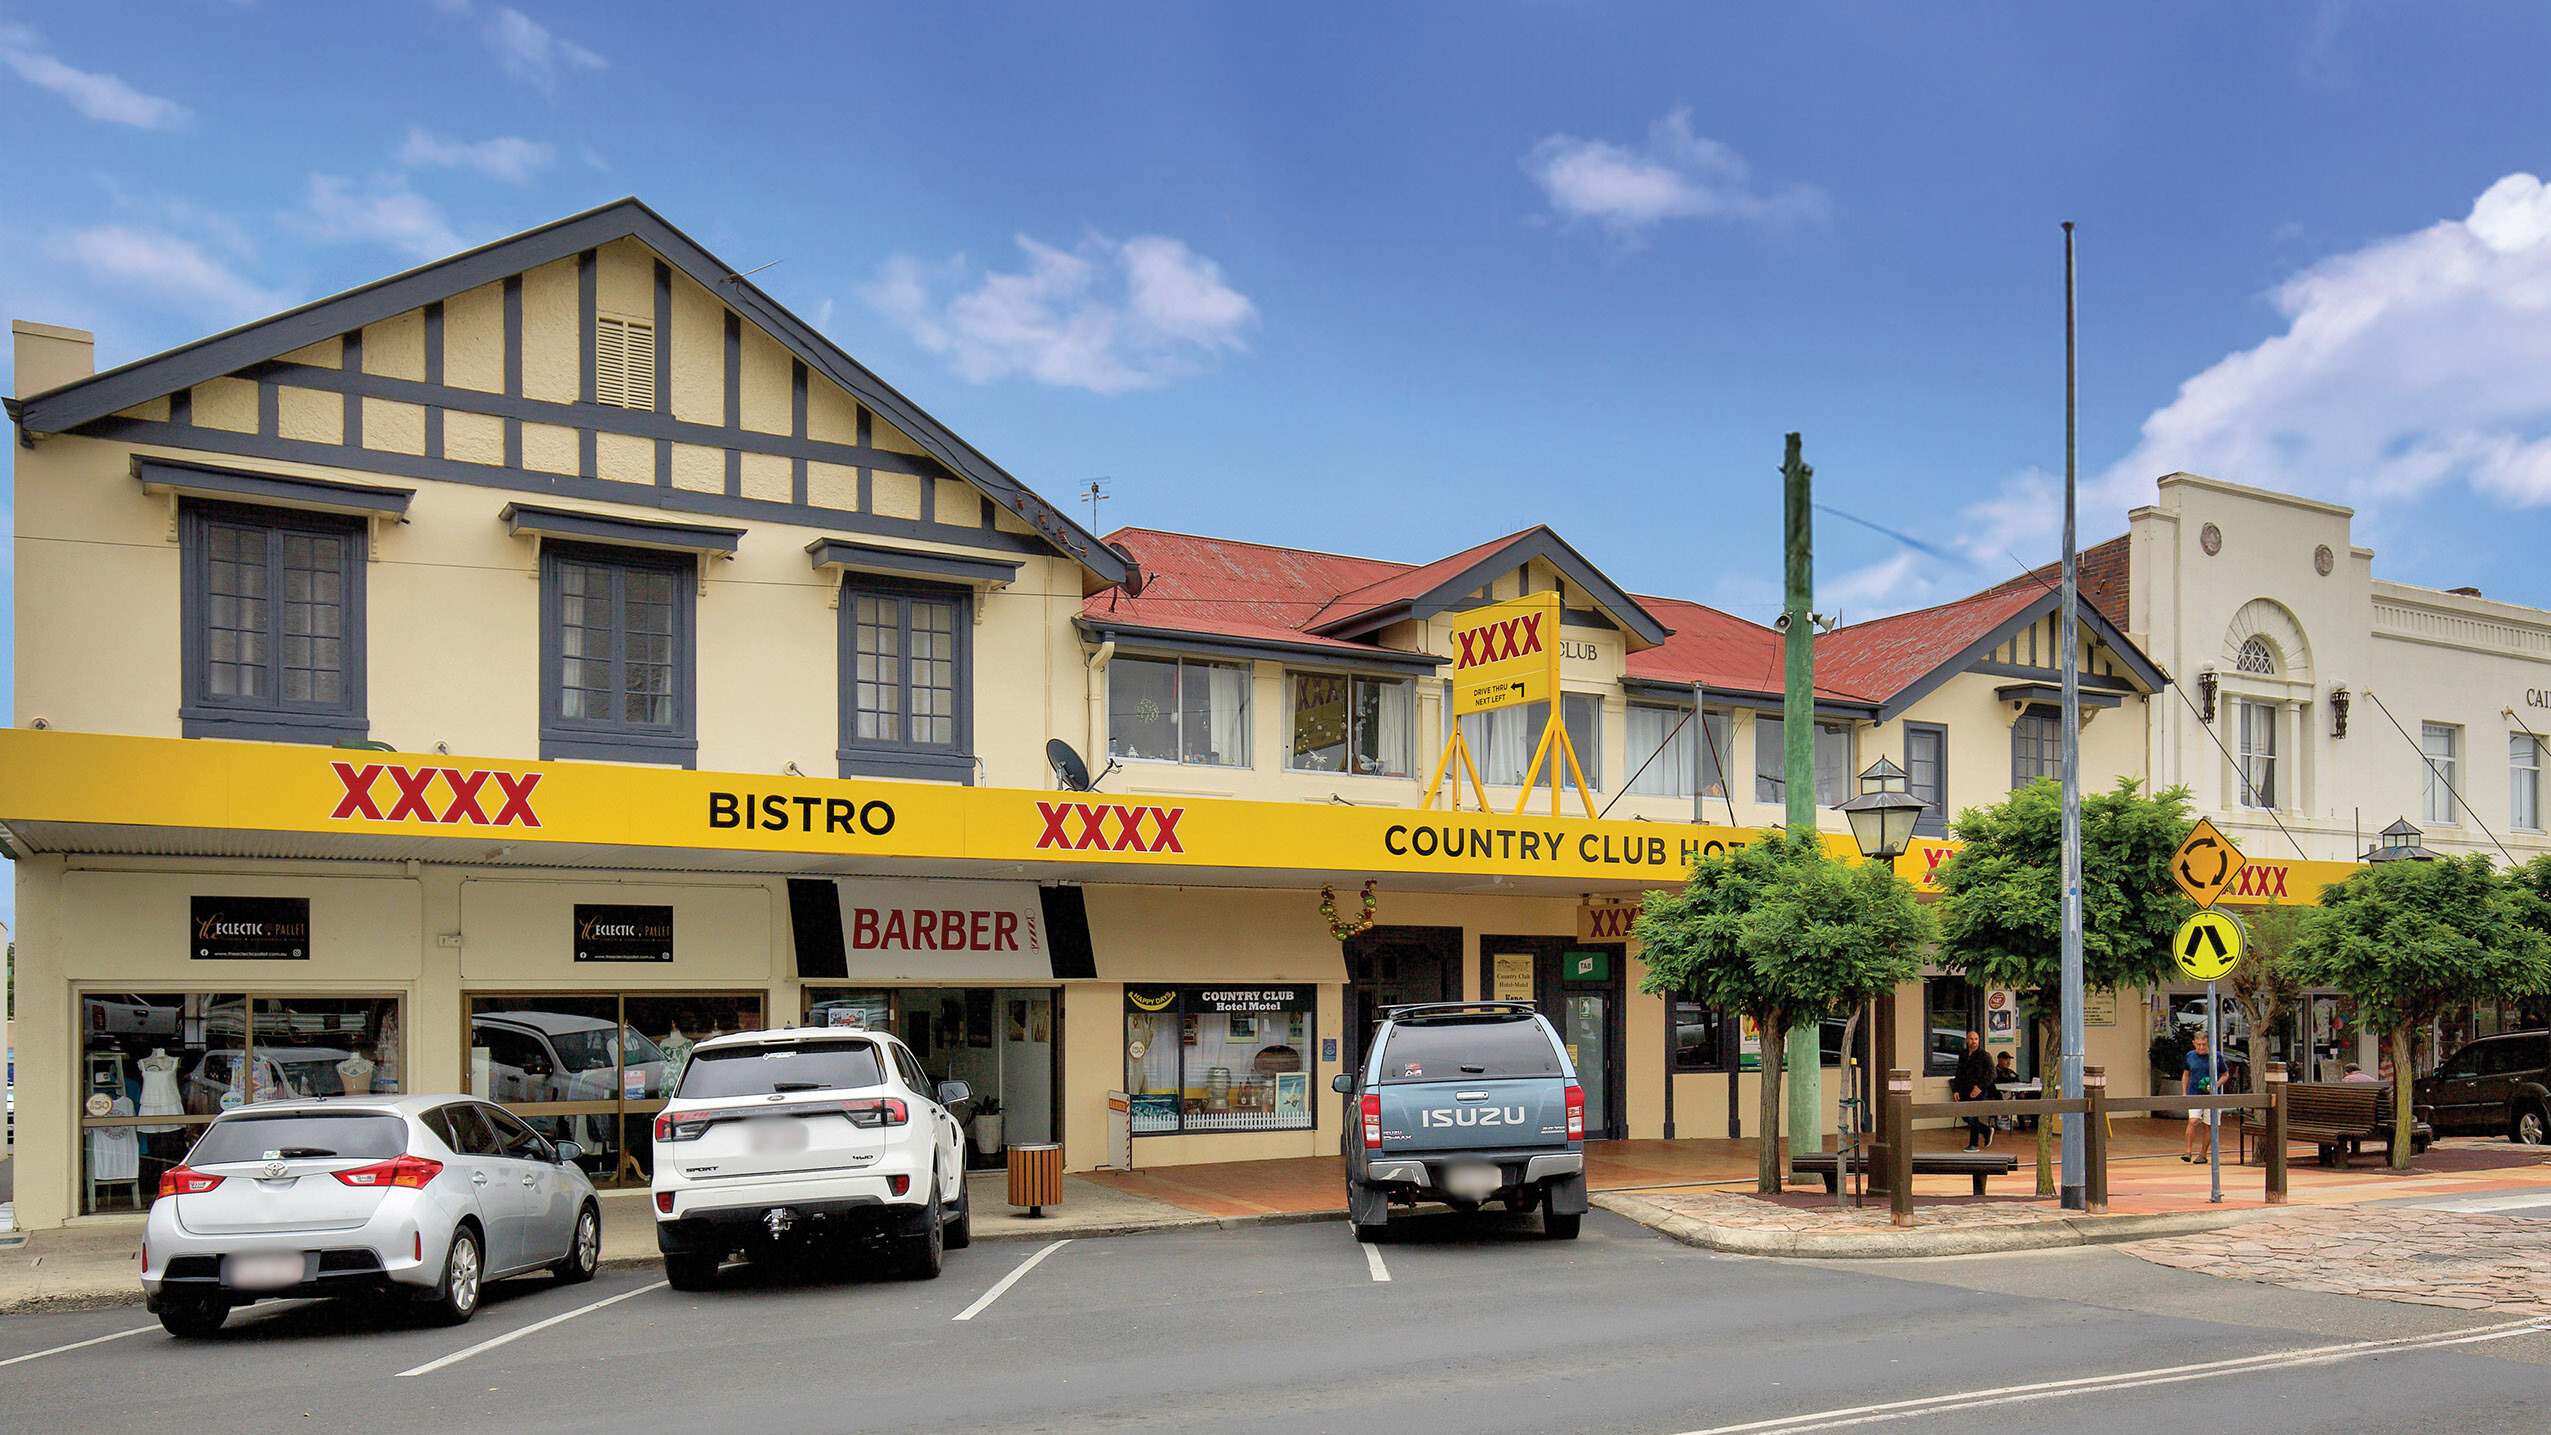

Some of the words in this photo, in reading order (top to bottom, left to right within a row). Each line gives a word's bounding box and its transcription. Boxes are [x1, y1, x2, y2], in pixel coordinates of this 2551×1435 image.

[1457, 611, 1543, 670] XXXX
[1473, 686, 1491, 697] DRIVE
[1492, 683, 1508, 694] THRU
[1475, 698, 1491, 706] NEXT
[1492, 694, 1506, 704] LEFT
[2526, 688, 2551, 709] CAI
[329, 761, 544, 828] XXXX
[710, 792, 896, 835] BISTRO
[1035, 801, 1184, 853] XXXX
[1385, 825, 1565, 861] COUNTRY
[1578, 834, 1667, 866] CLUB
[216, 923, 262, 935] ECLECTIC
[596, 925, 635, 936] ECLECTIC
[852, 908, 1019, 951] BARBER
[1590, 908, 1640, 937] XXX
[1580, 961, 1591, 970] TAB
[1133, 992, 1154, 1005] HAPPY
[1155, 992, 1171, 1004] DAYS
[1202, 991, 1260, 1001] COUNTRY
[1263, 991, 1294, 1000] CLUB
[1216, 1002, 1247, 1011] Hotel
[1249, 1001, 1280, 1011] Motel
[1422, 1106, 1526, 1128] ISUZU
